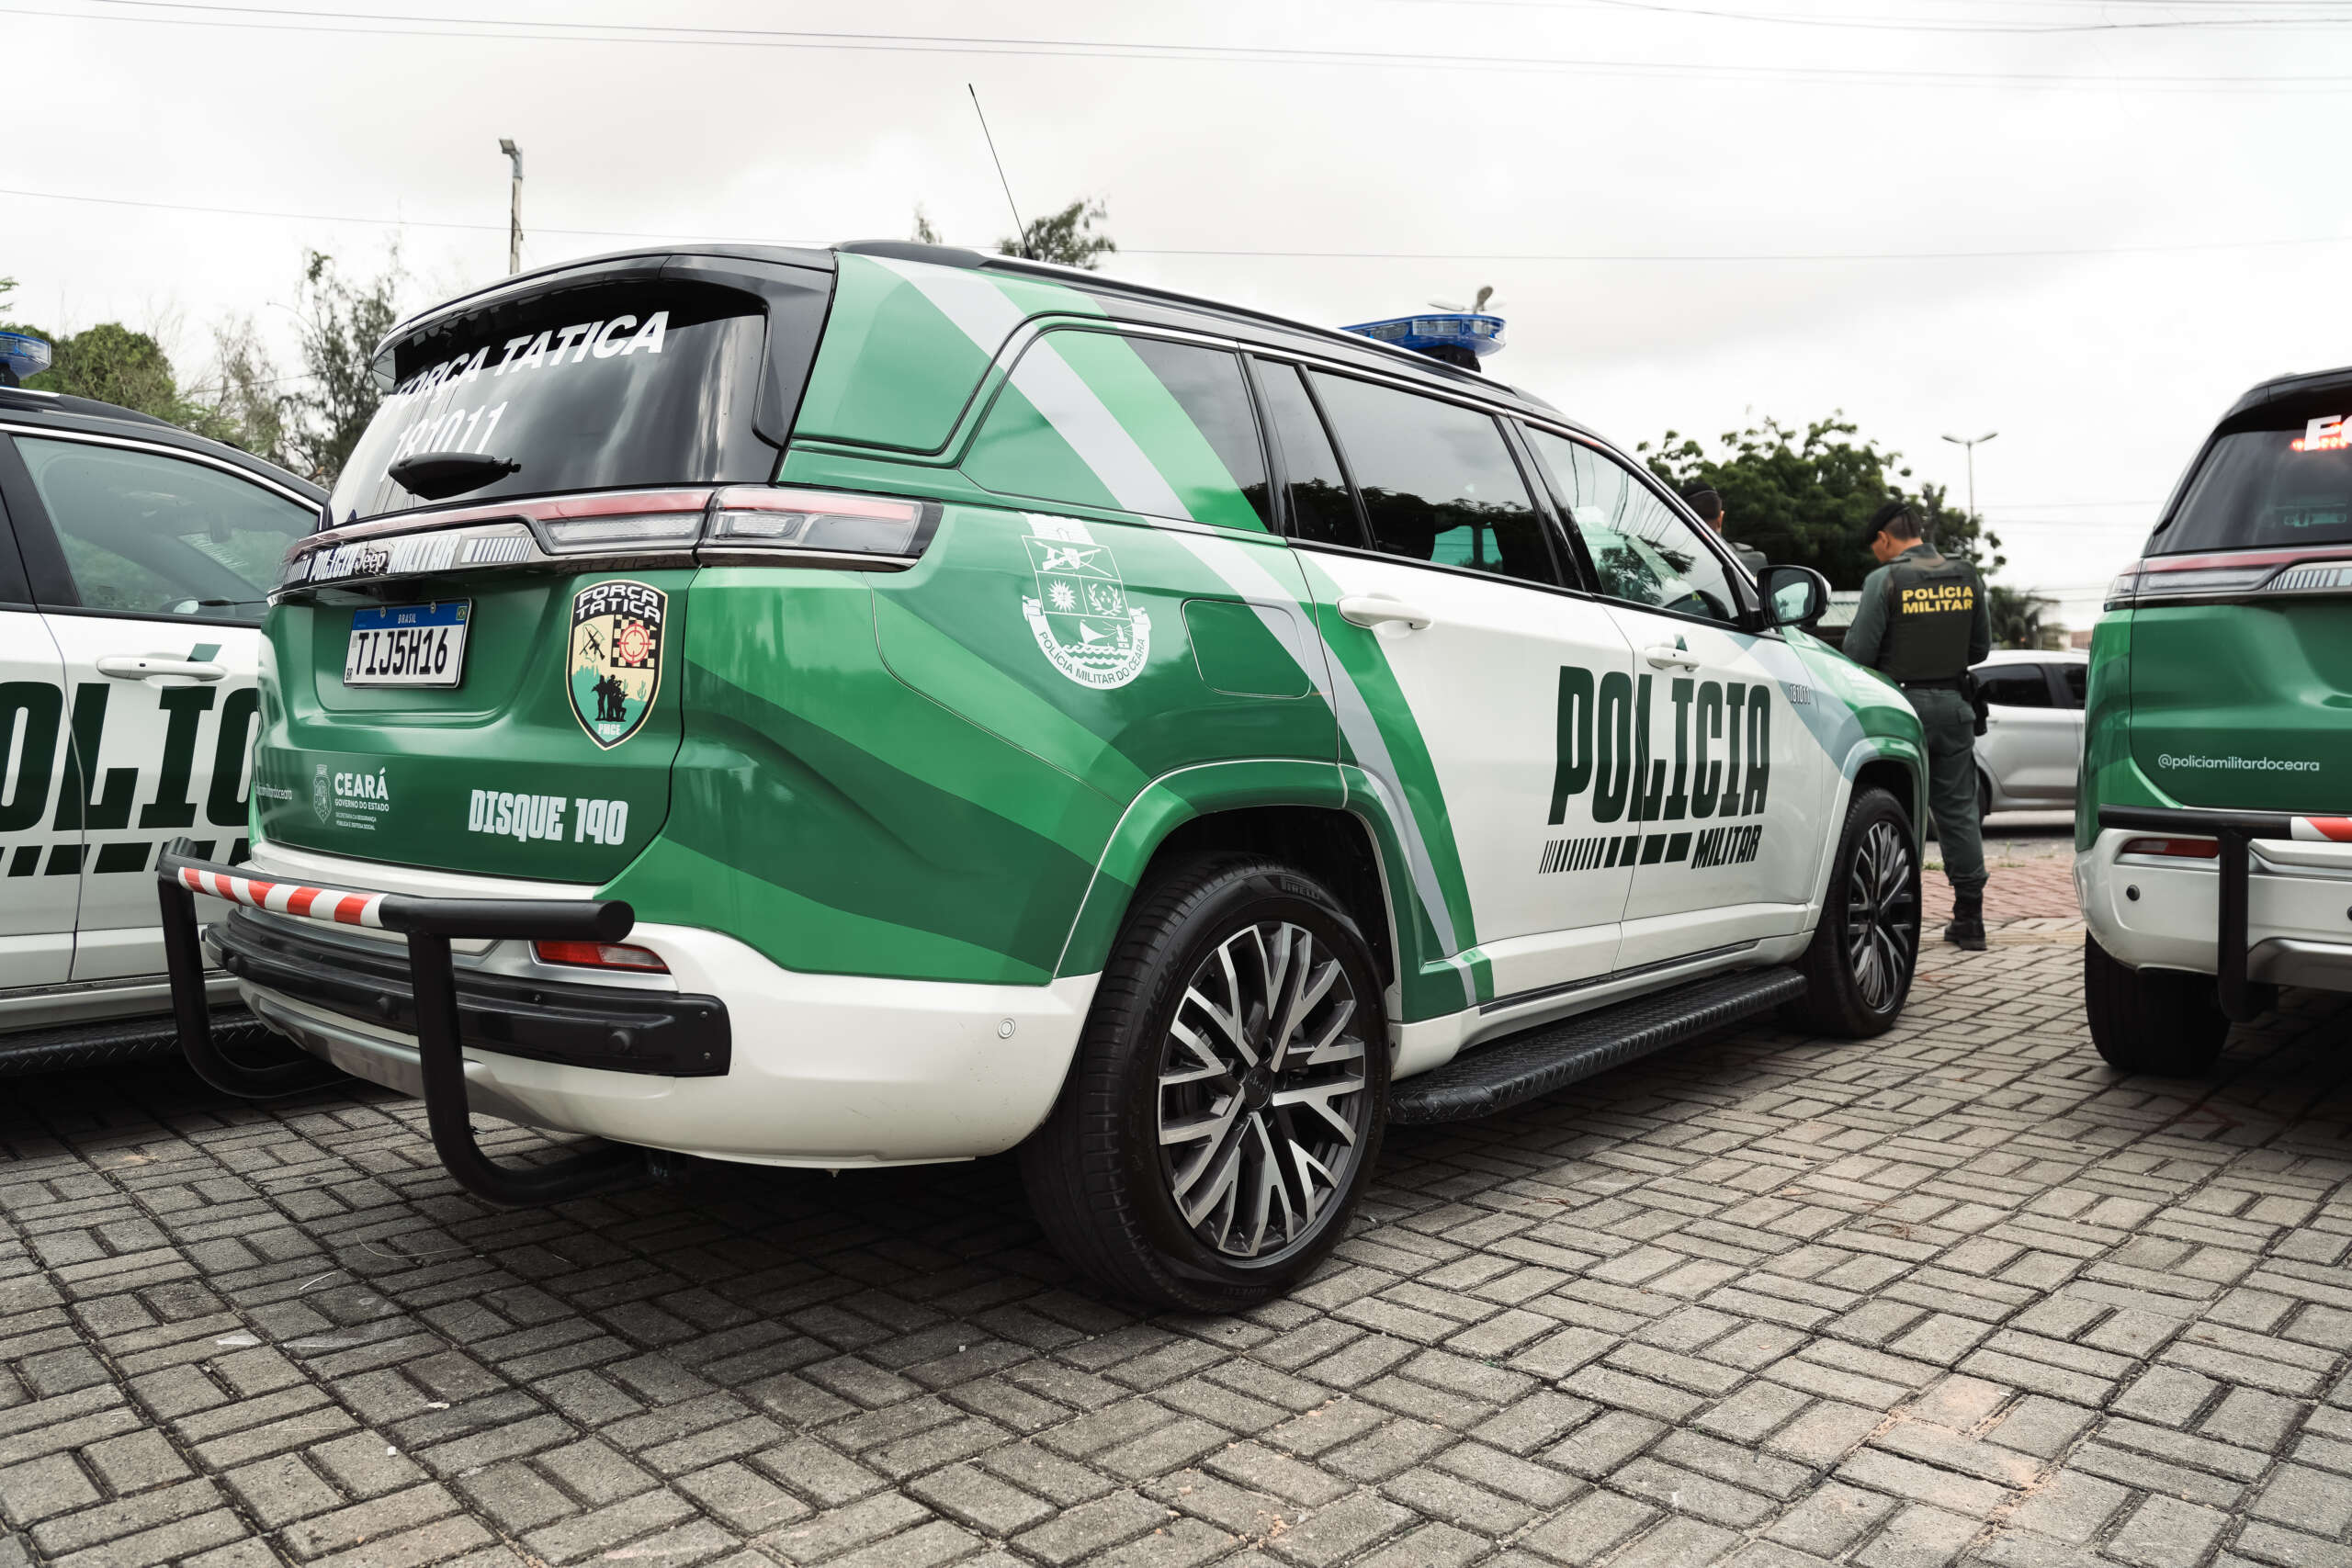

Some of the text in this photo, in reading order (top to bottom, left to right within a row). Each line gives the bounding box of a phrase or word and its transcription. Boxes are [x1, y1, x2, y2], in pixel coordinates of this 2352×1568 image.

[493, 310, 670, 377] TATICA
[2303, 414, 2352, 451] F
[353, 547, 389, 576] Jeep
[387, 533, 461, 575] MILITAR
[578, 584, 659, 609] FORÇA
[1902, 584, 1973, 602] POLÍCIA
[1903, 598, 1973, 615] MILITAR
[397, 613, 417, 625] BRASIL
[575, 597, 662, 624] TATICA
[356, 627, 449, 676] TIJ5H16
[1039, 631, 1073, 674] POLÍCIA
[1076, 668, 1115, 684] MILITAR
[1116, 667, 1130, 682] DO
[597, 723, 622, 736] PMCE
[1548, 665, 1770, 825] POLICIA
[2157, 753, 2320, 772] @policiamilitardoceara
[334, 766, 390, 800] CEARÁ
[334, 797, 390, 812] GOVERNO DO ESTADO
[468, 789, 629, 845] DISQUE 190
[1690, 825, 1763, 869] MILITAR
